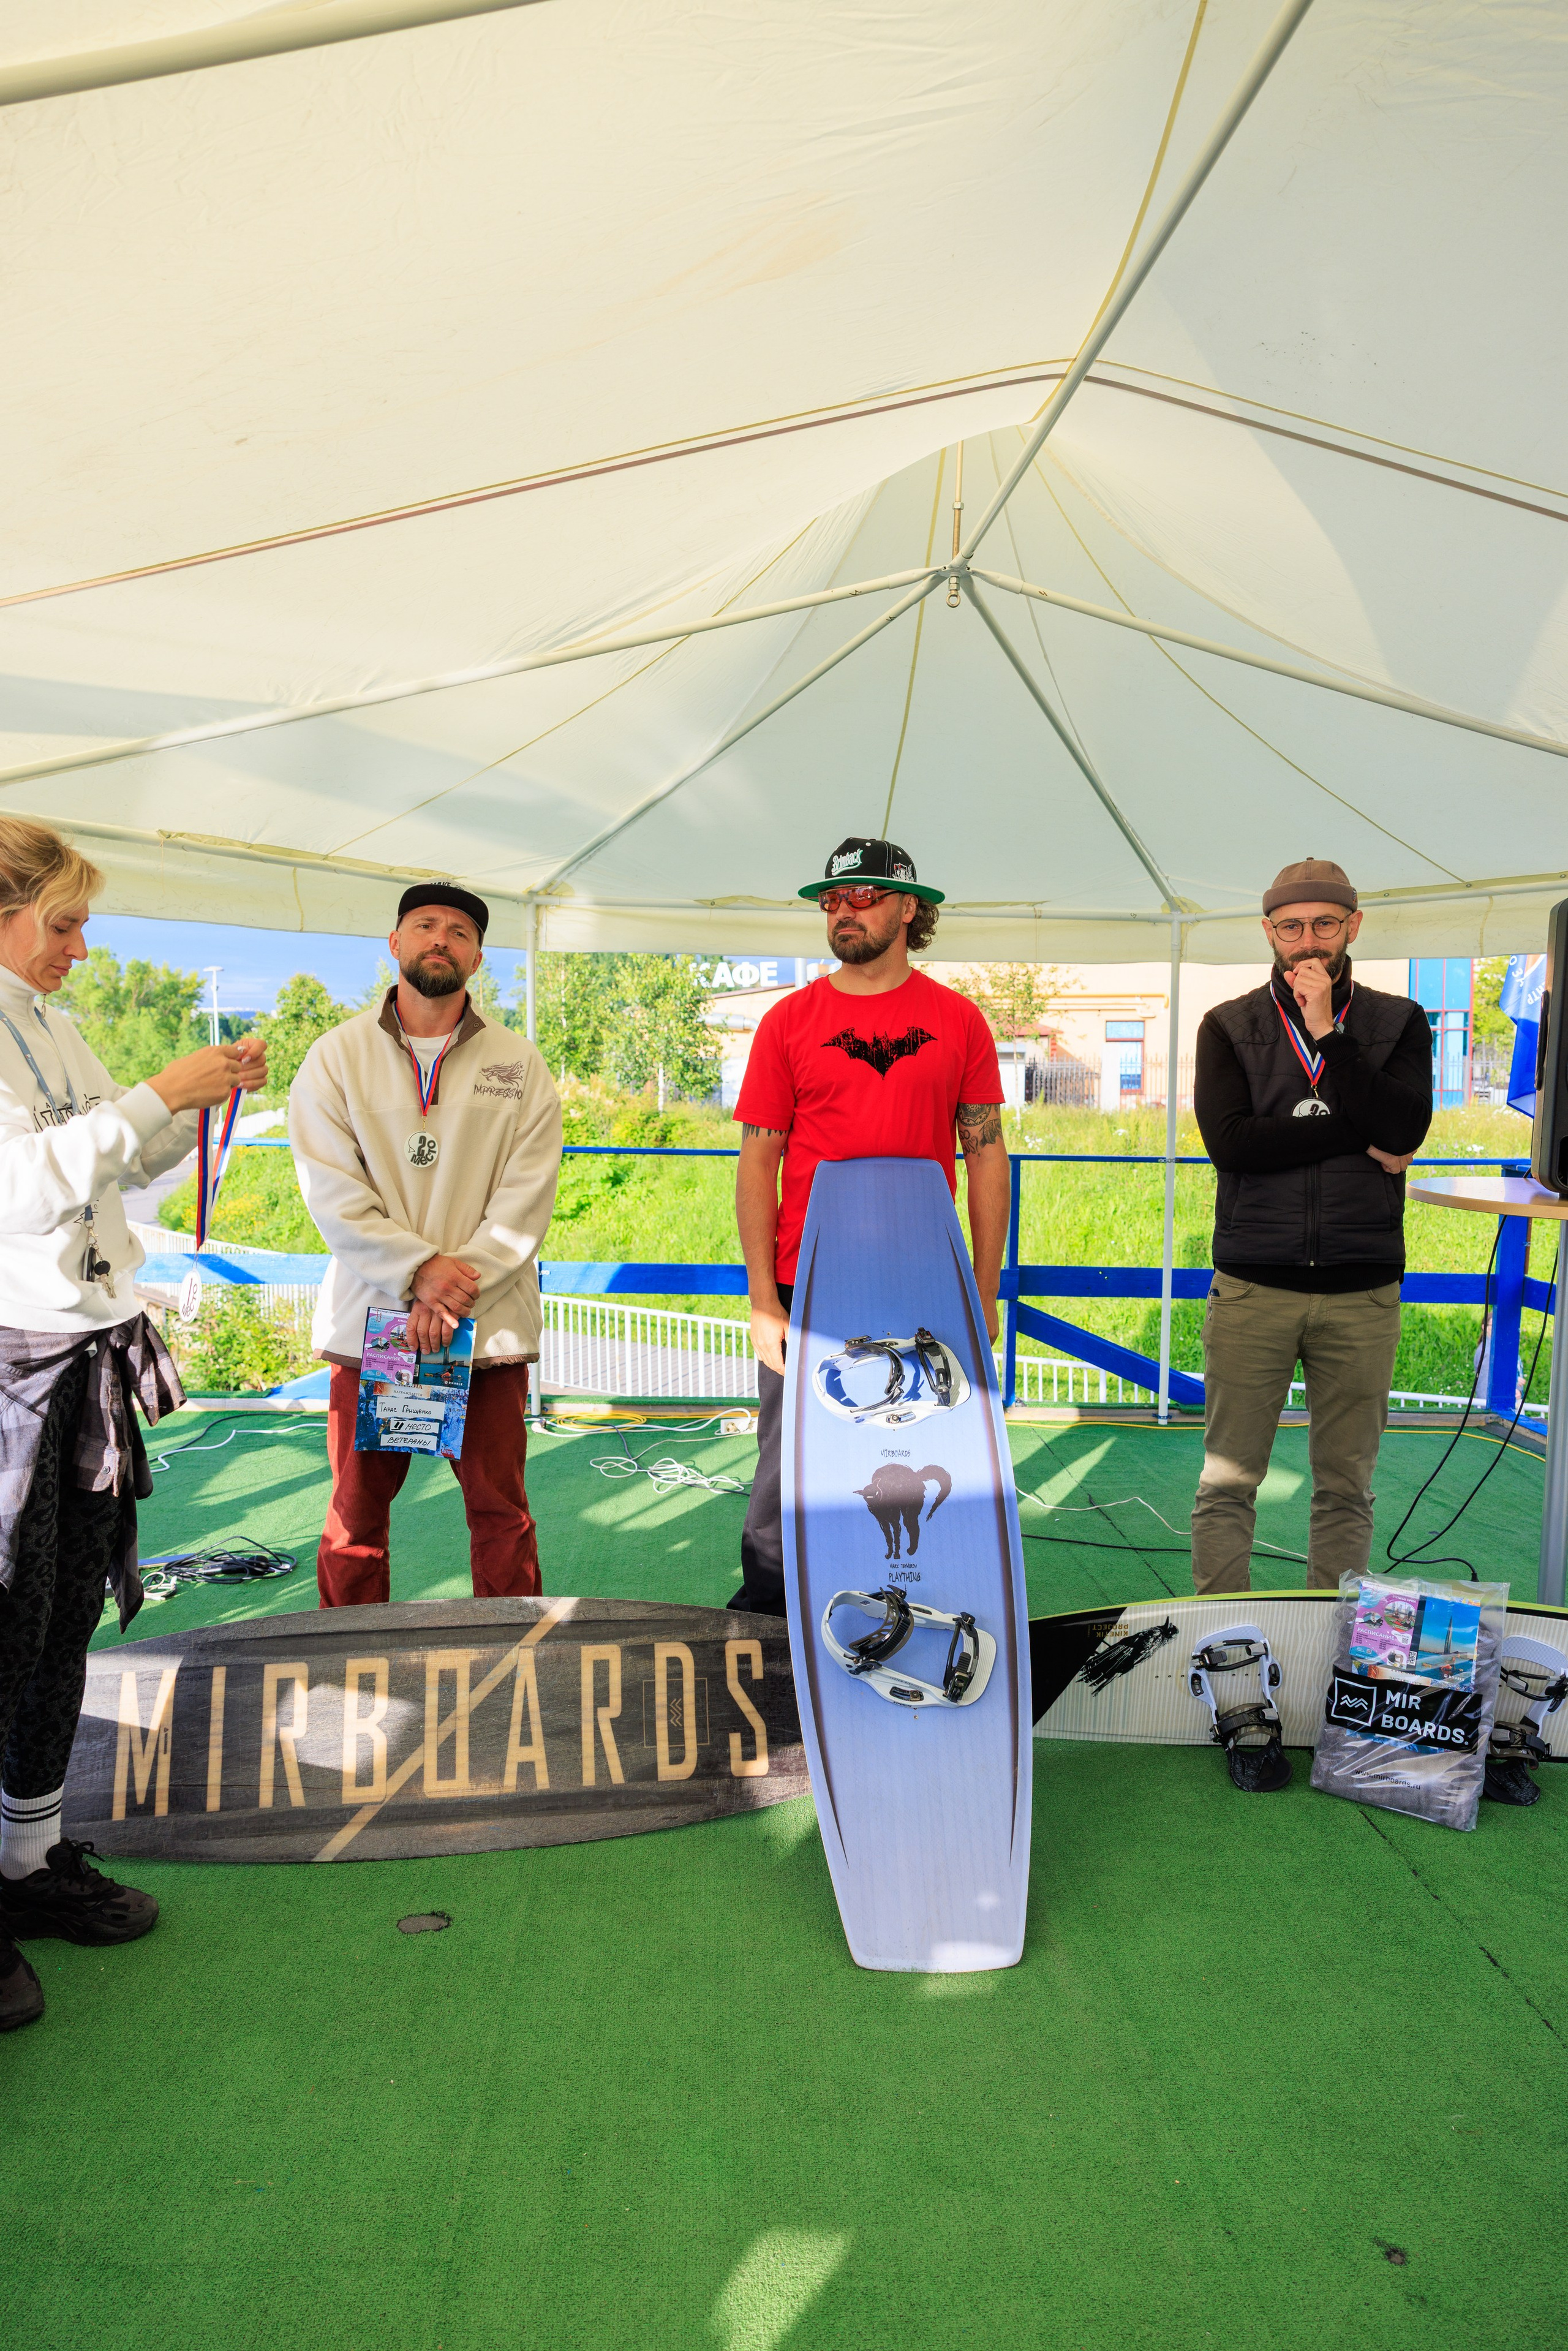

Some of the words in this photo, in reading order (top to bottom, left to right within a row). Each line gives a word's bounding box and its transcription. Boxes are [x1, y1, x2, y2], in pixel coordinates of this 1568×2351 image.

[417, 1135, 427, 1157] 2
[366, 1352, 401, 1361] РАСПИСАНИЕ
[889, 1571, 921, 1583] PLAYTHING
[1357, 1627, 1395, 1640] РАСПИСАНИЕ
[1385, 1689, 1421, 1710] MIR
[112, 1639, 770, 1821] MIRBOARDS
